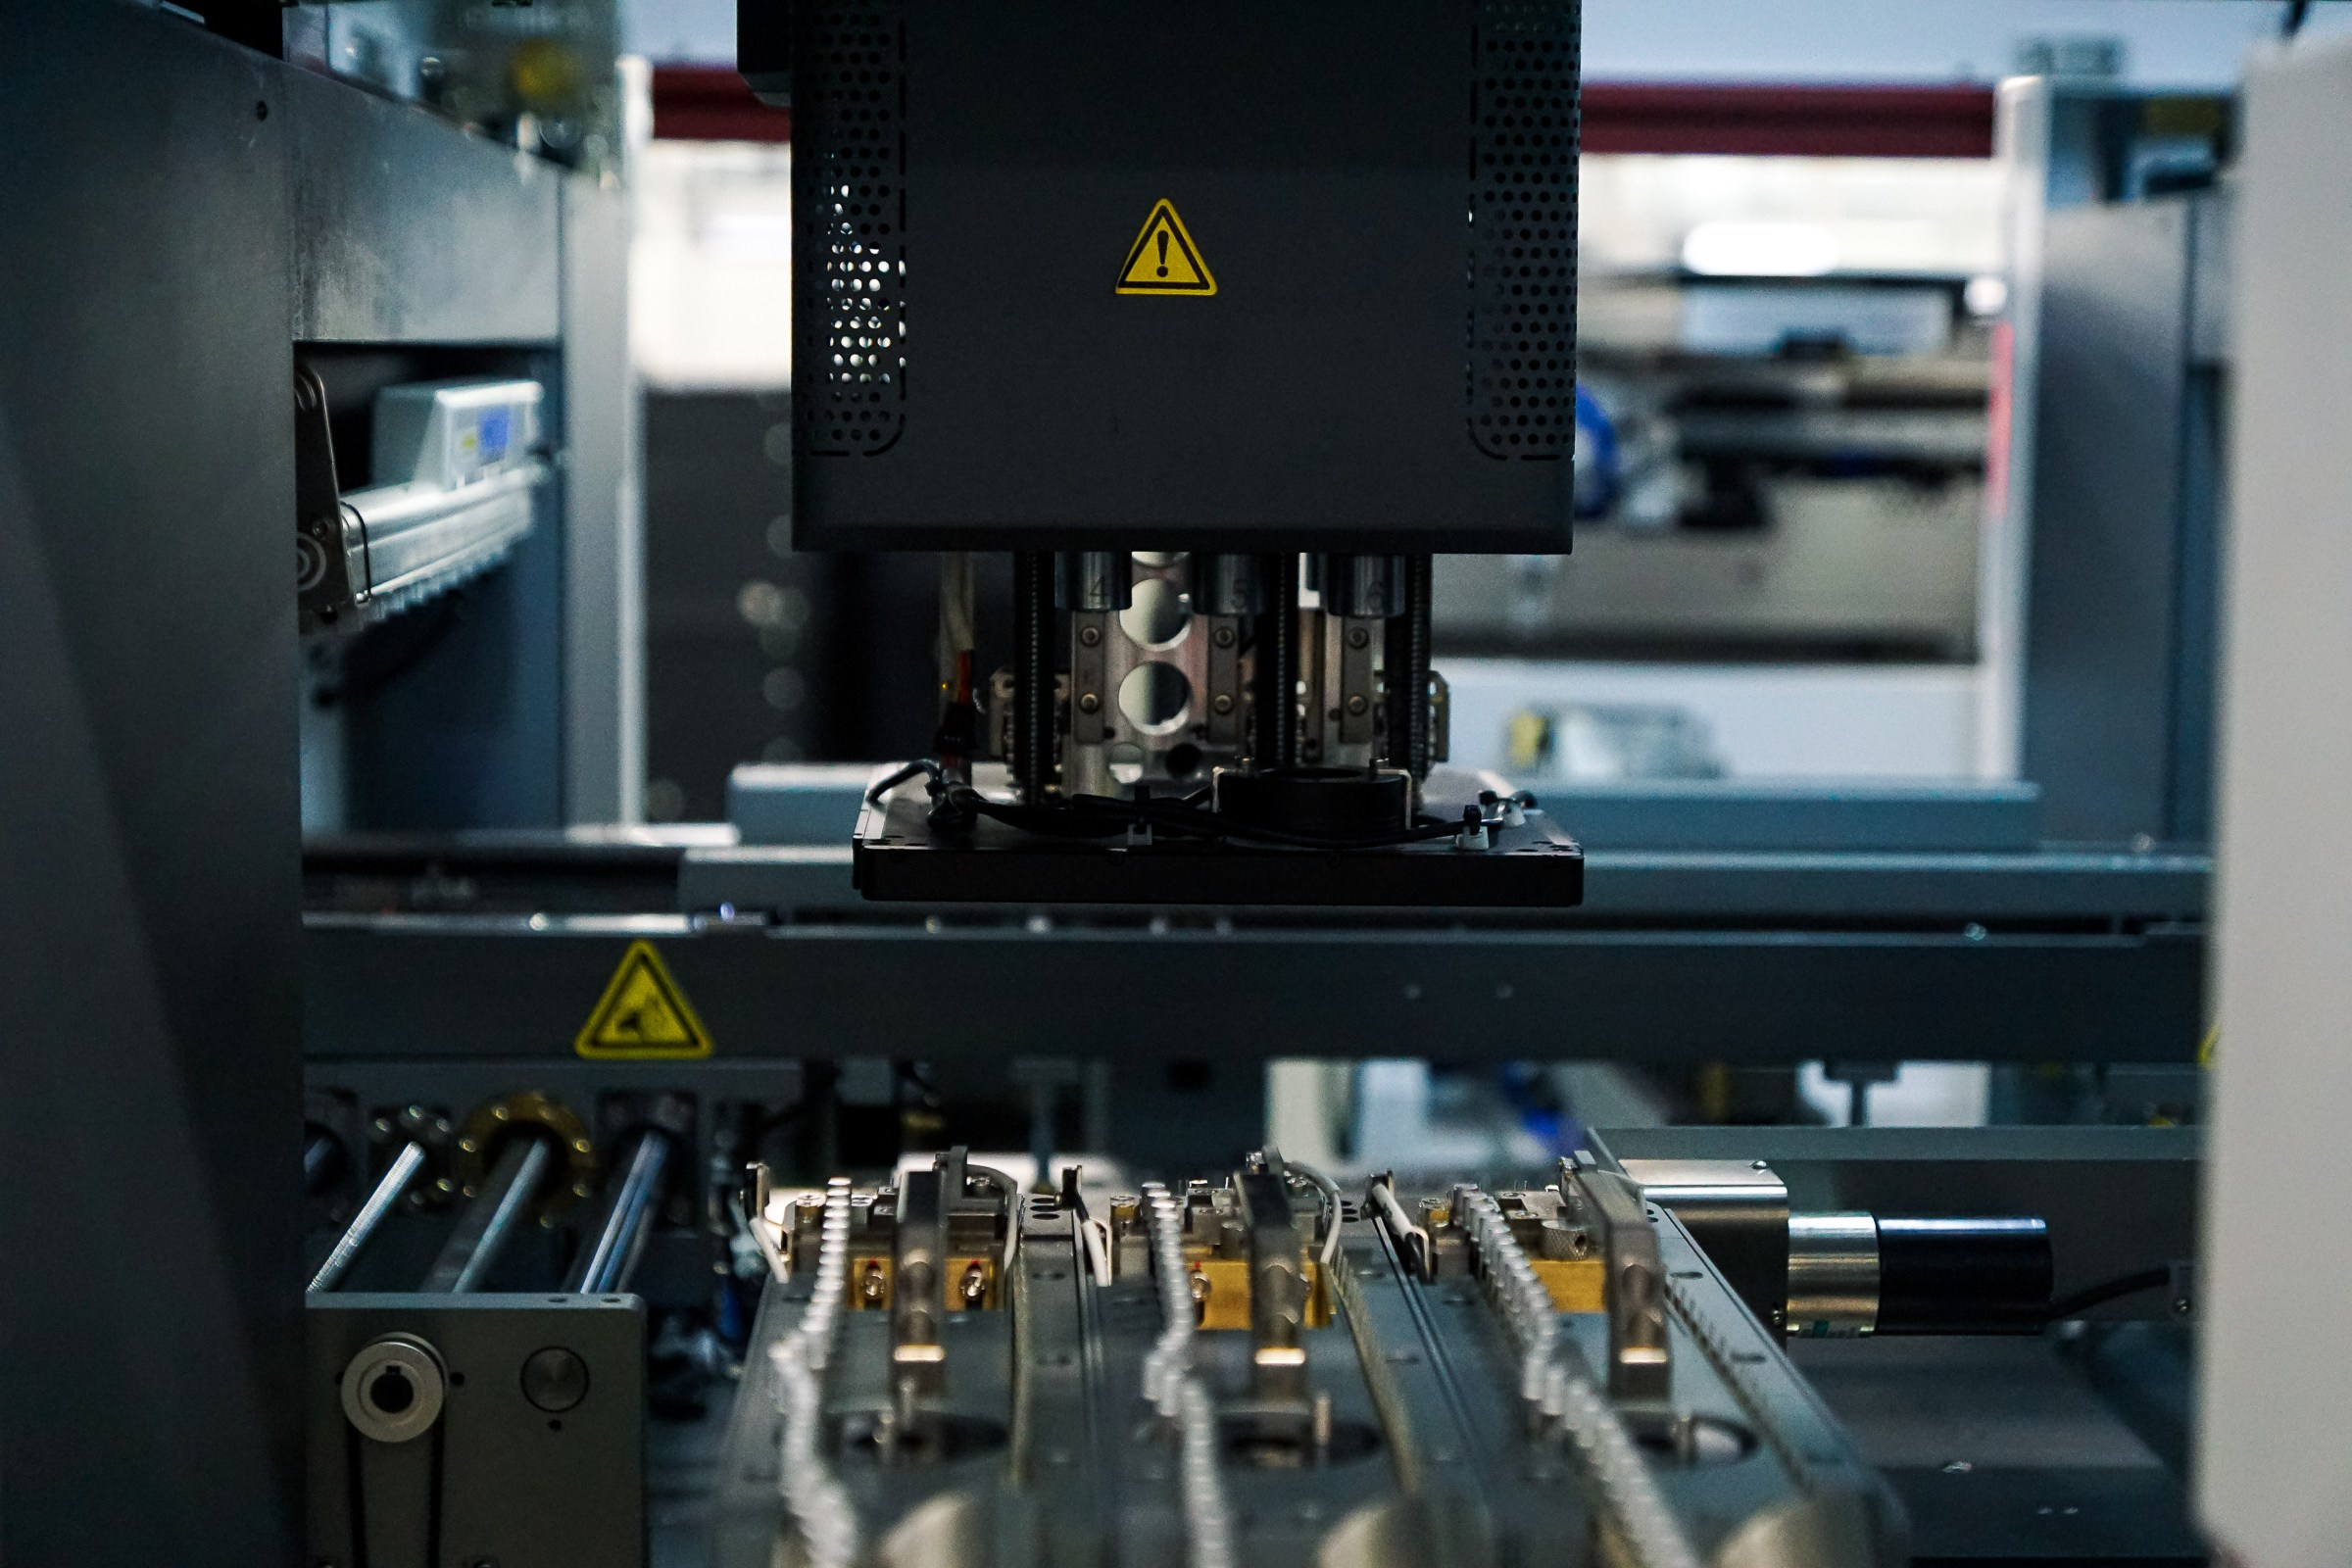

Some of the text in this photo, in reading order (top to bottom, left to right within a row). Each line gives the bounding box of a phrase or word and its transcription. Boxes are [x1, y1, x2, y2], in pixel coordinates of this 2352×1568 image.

[1089, 575, 1109, 606] 4
[1231, 578, 1249, 609] 5
[1366, 579, 1385, 611] 6
